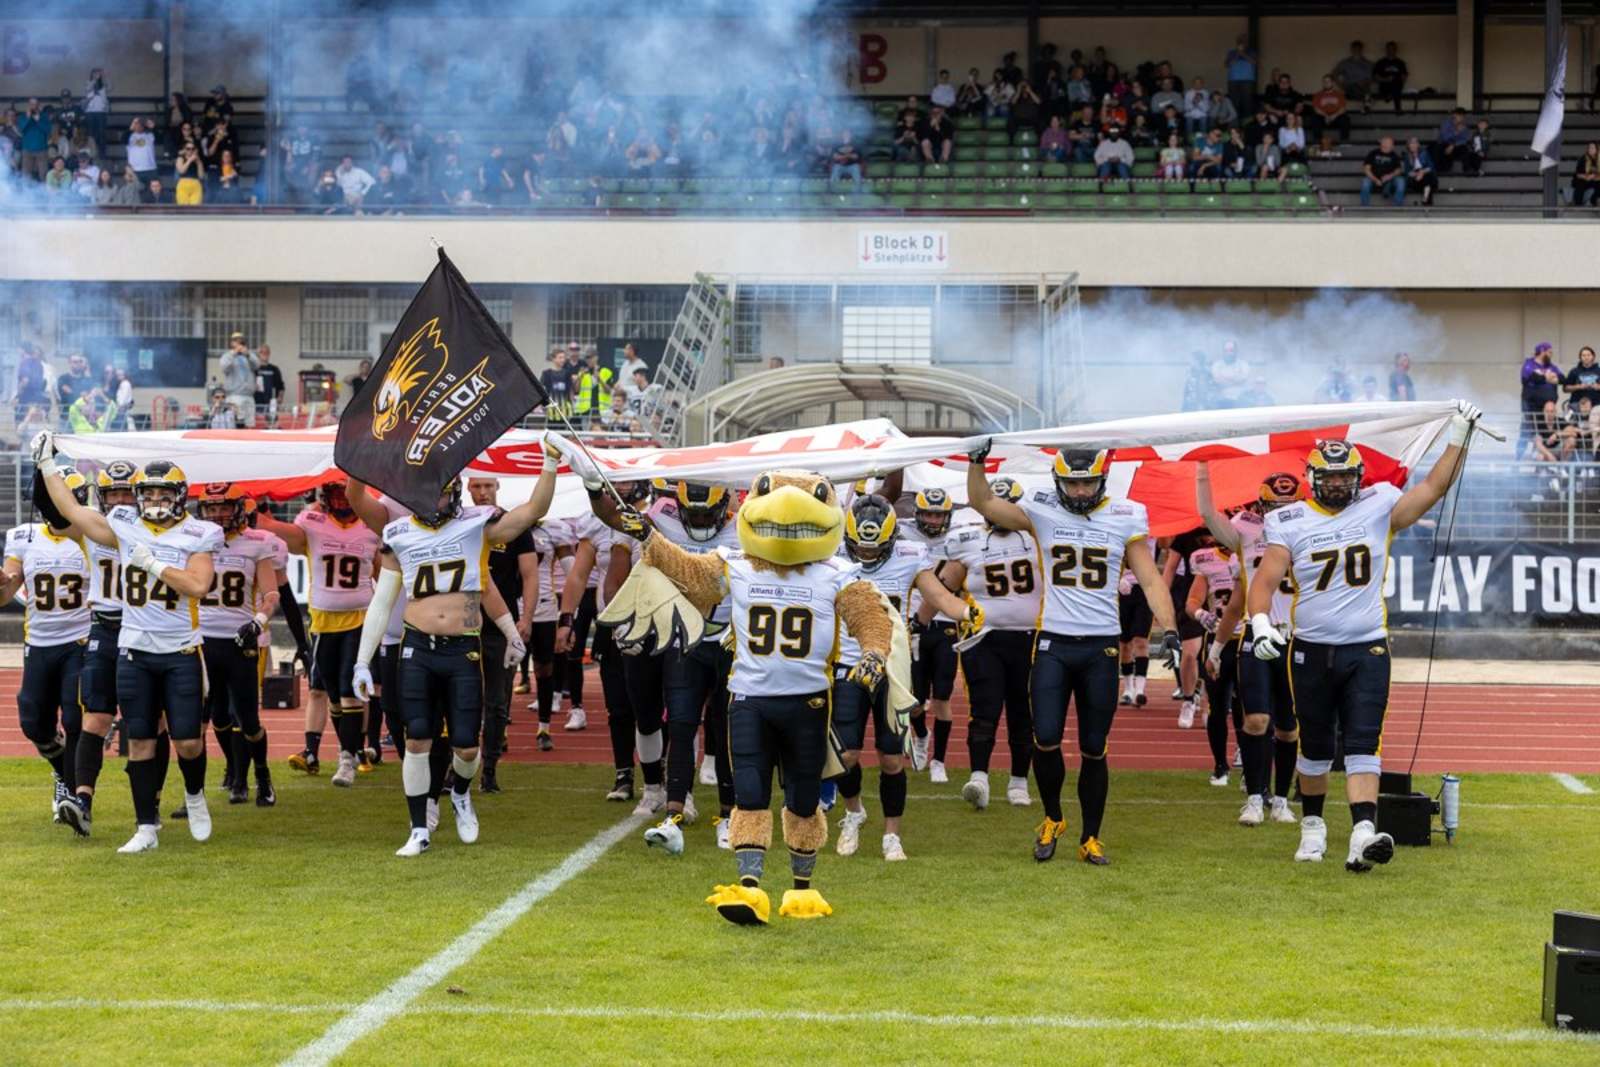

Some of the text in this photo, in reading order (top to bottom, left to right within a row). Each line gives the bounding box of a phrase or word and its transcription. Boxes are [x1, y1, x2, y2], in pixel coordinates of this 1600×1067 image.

[860, 34, 888, 84] B
[873, 235, 934, 249] Block D
[125, 563, 180, 611] 84
[322, 553, 360, 589] 19
[413, 559, 466, 598] 47
[984, 558, 1034, 597] 59
[1050, 544, 1108, 589] 25
[1310, 544, 1372, 592] 70
[1512, 555, 1600, 614] FOO
[33, 572, 83, 611] 93
[750, 587, 774, 595] Allianz
[748, 605, 813, 659] 99
